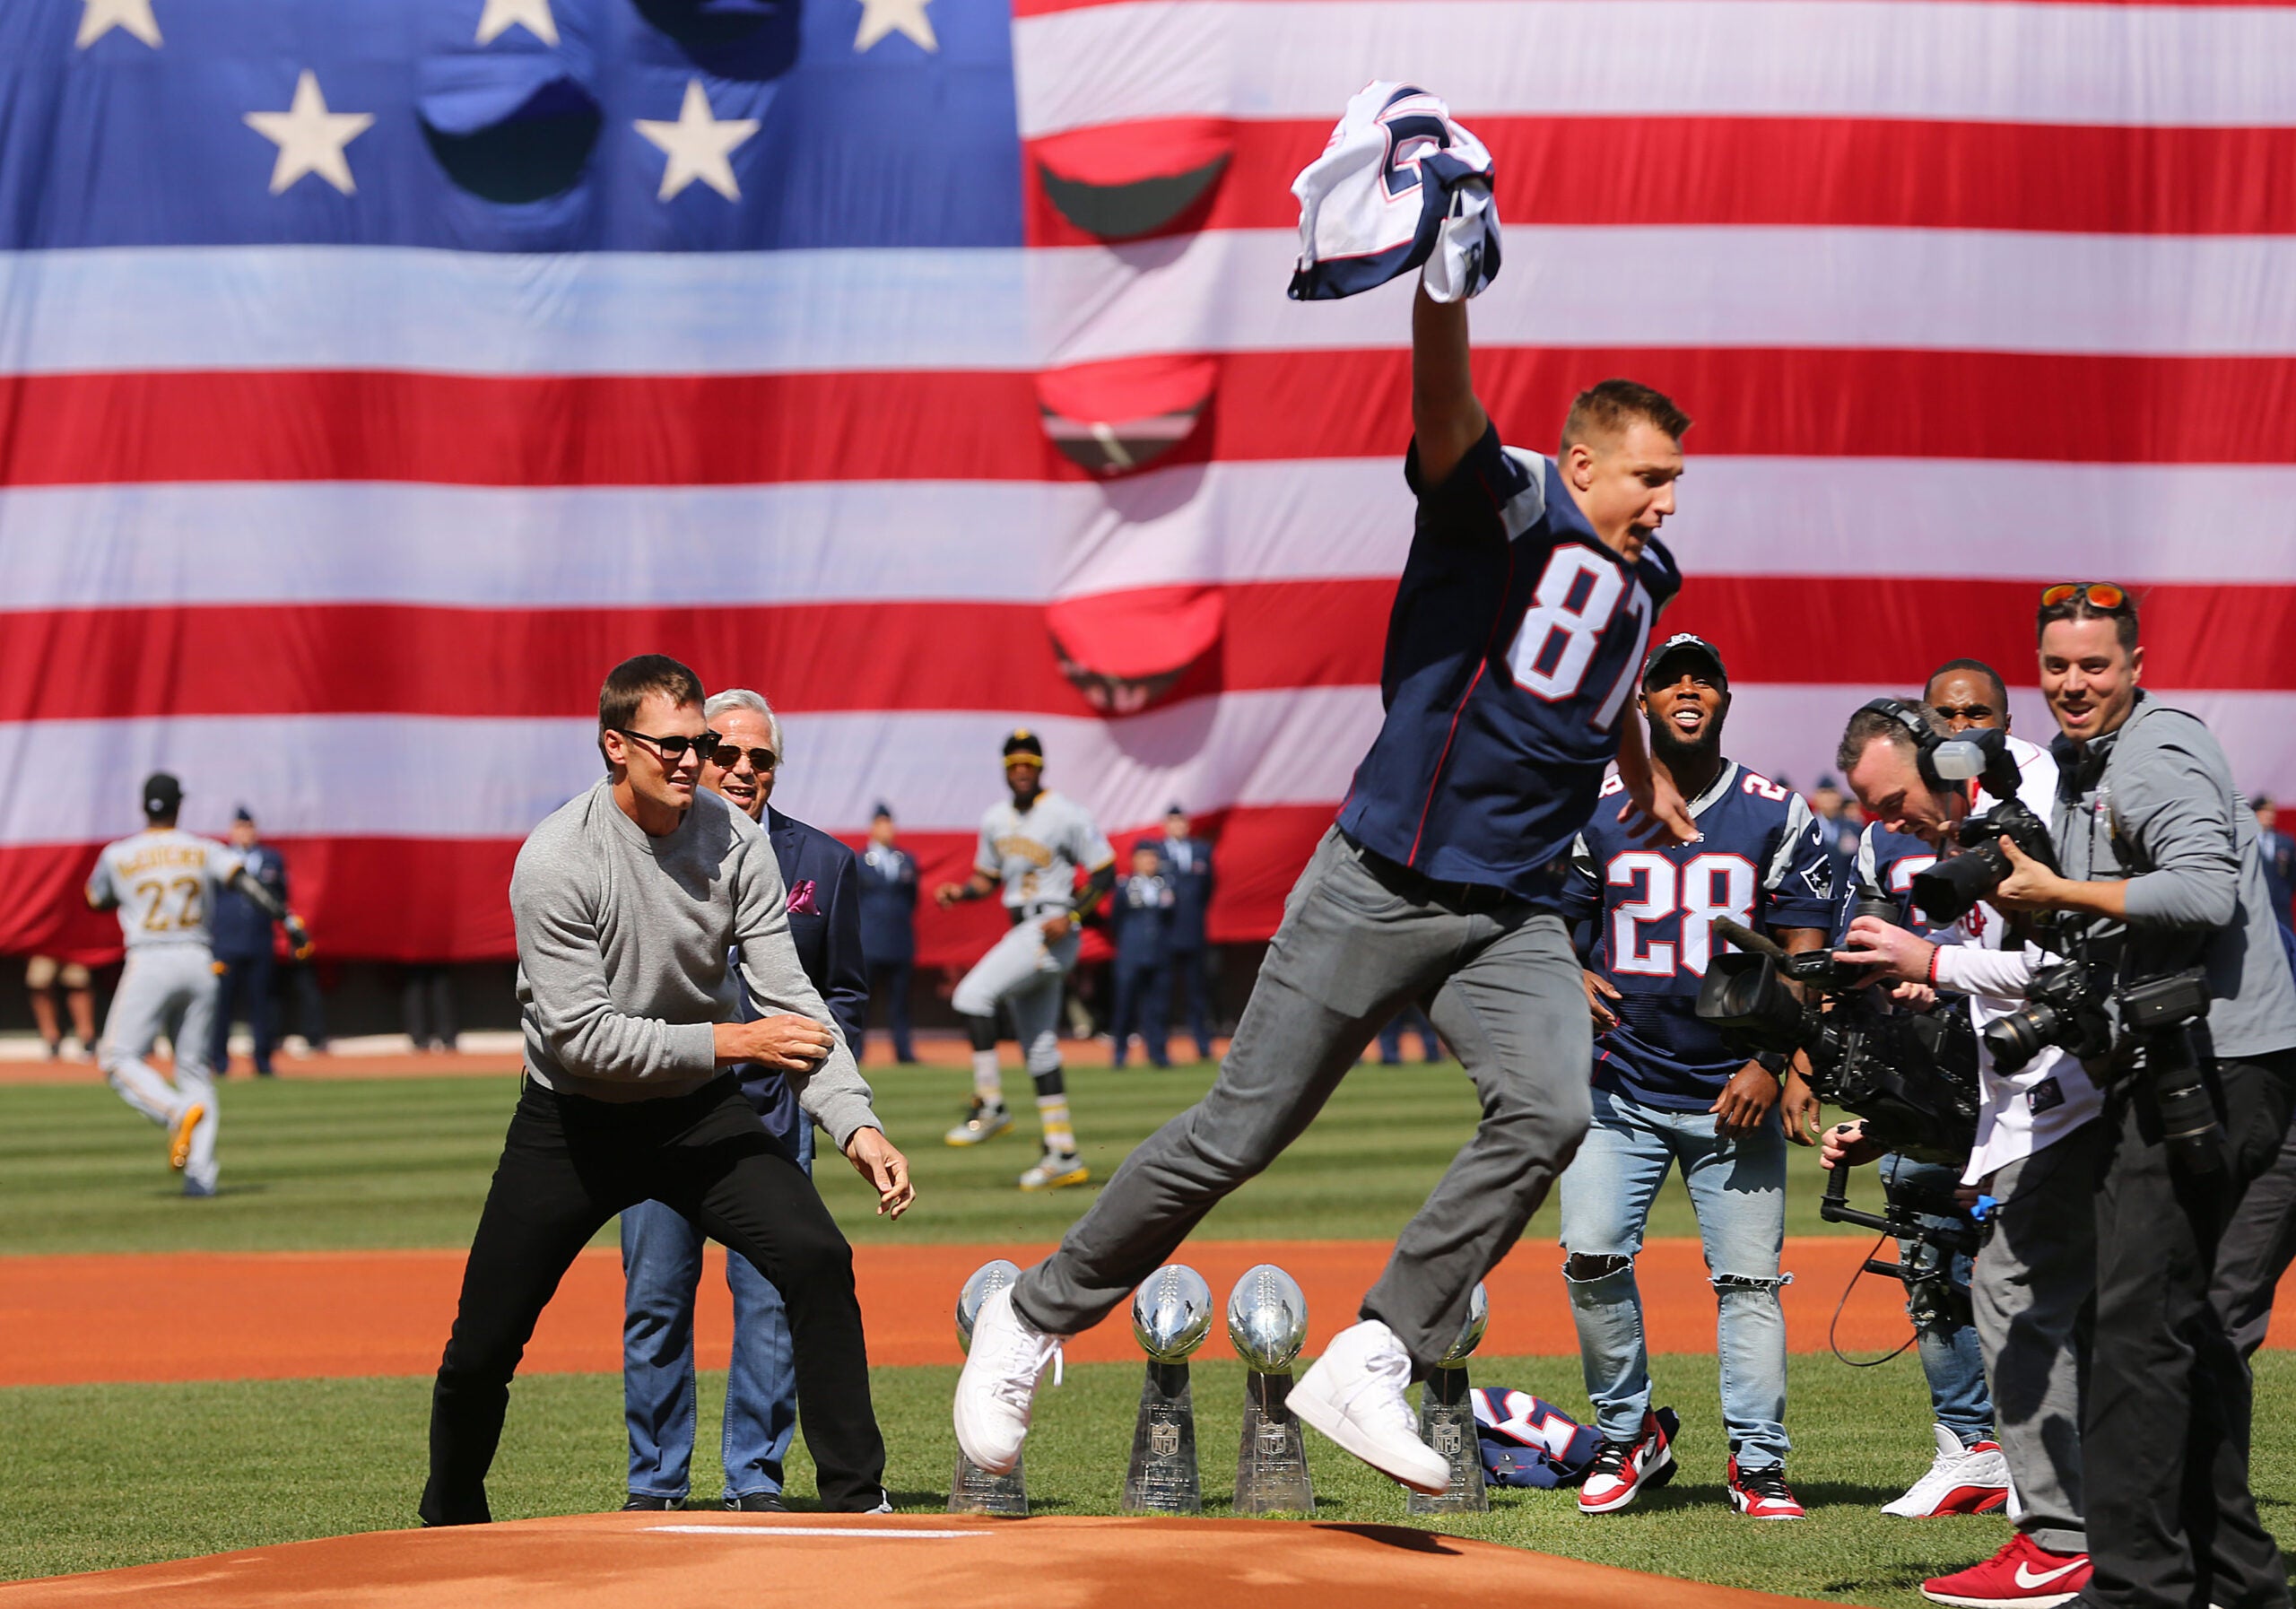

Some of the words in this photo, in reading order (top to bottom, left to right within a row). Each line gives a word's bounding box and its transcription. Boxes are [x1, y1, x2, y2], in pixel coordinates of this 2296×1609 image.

[1503, 542, 1653, 735] 87
[136, 875, 202, 931] 22
[1605, 850, 1758, 978] 28
[1152, 1437, 1177, 1452] NFL
[1258, 1437, 1283, 1452] NFL
[1434, 1437, 1459, 1451] NFL
